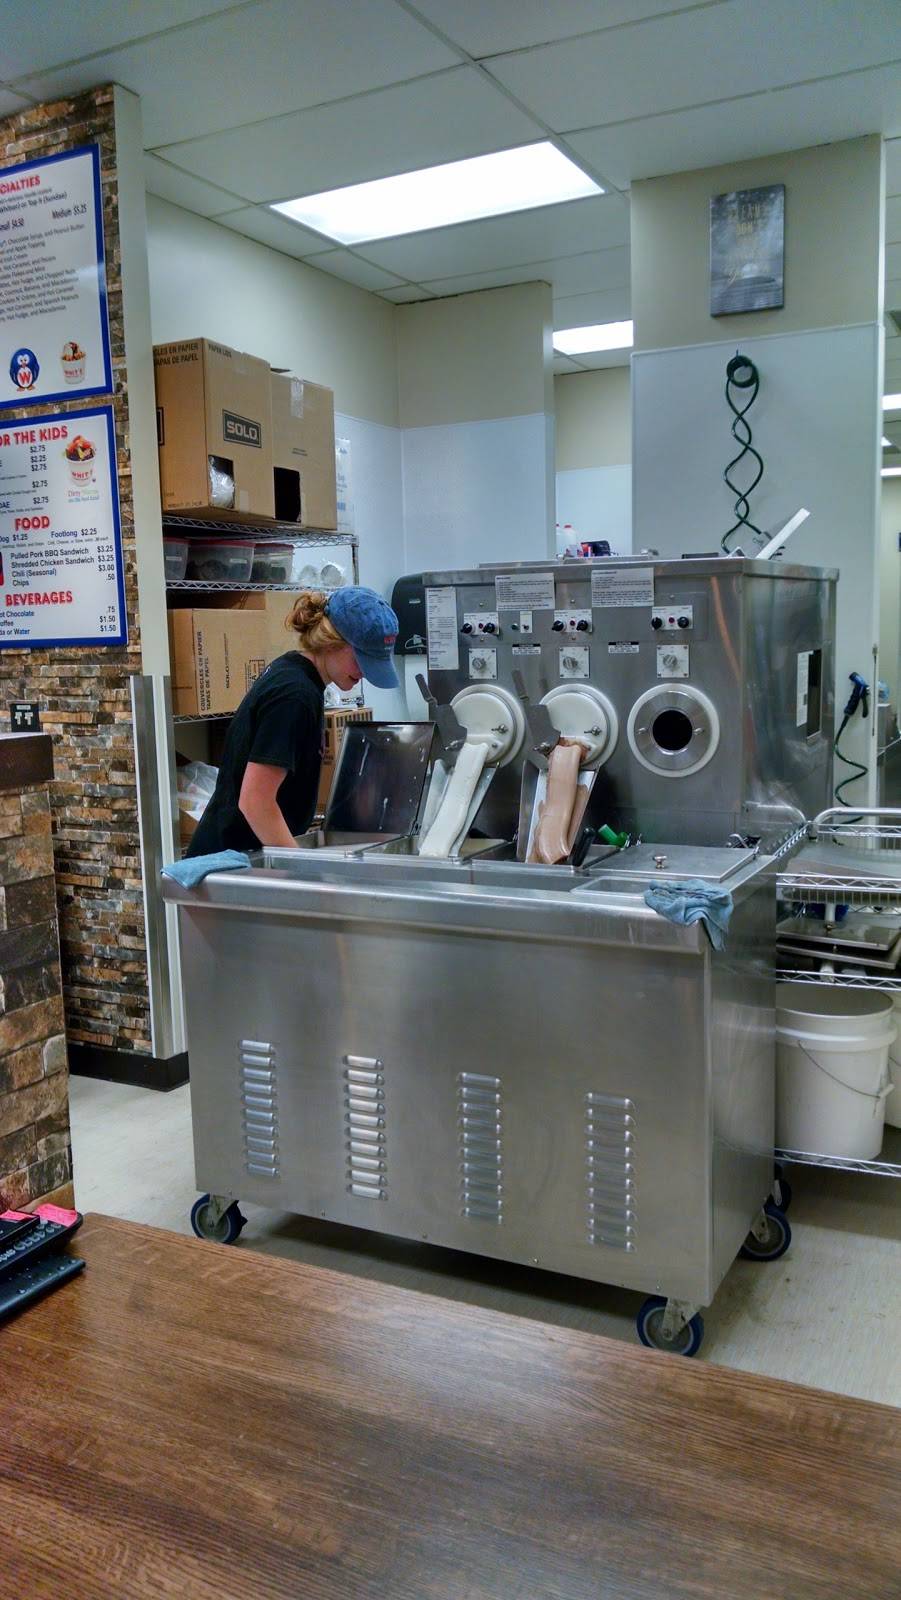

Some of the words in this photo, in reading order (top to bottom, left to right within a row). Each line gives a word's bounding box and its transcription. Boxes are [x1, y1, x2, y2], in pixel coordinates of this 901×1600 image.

[169, 345, 177, 353] EN
[178, 342, 199, 353] PAPIER
[172, 356, 180, 364] DE
[181, 353, 199, 363] PAPEL
[13, 430, 37, 446] THE
[39, 425, 68, 443] KIDS
[227, 420, 257, 440] SOLO
[30, 444, 46, 454] $2.75
[31, 463, 48, 472] $2.75
[32, 479, 49, 489] $2.75
[33, 496, 49, 505] $2.75
[15, 515, 51, 532] FOOD
[51, 528, 78, 540] Footlong
[81, 527, 98, 537] $2.25
[11, 552, 29, 560] Pulled
[30, 551, 44, 559] Pork
[45, 549, 59, 557] BBQ
[60, 546, 90, 556] Sandwich
[97, 545, 115, 553] $3.25
[11, 560, 39, 569] Shredded
[40, 558, 64, 567] Chicken
[65, 555, 95, 565] Sandwich
[98, 554, 115, 563] $3.25
[12, 570, 25, 578] Chili
[26, 568, 57, 578] (Seasonal)
[98, 563, 115, 572] $3.00
[12, 579, 30, 588] Chips
[6, 591, 73, 607] BEVERAGES
[6, 609, 34, 618] Chocolate
[13, 627, 30, 635] Water
